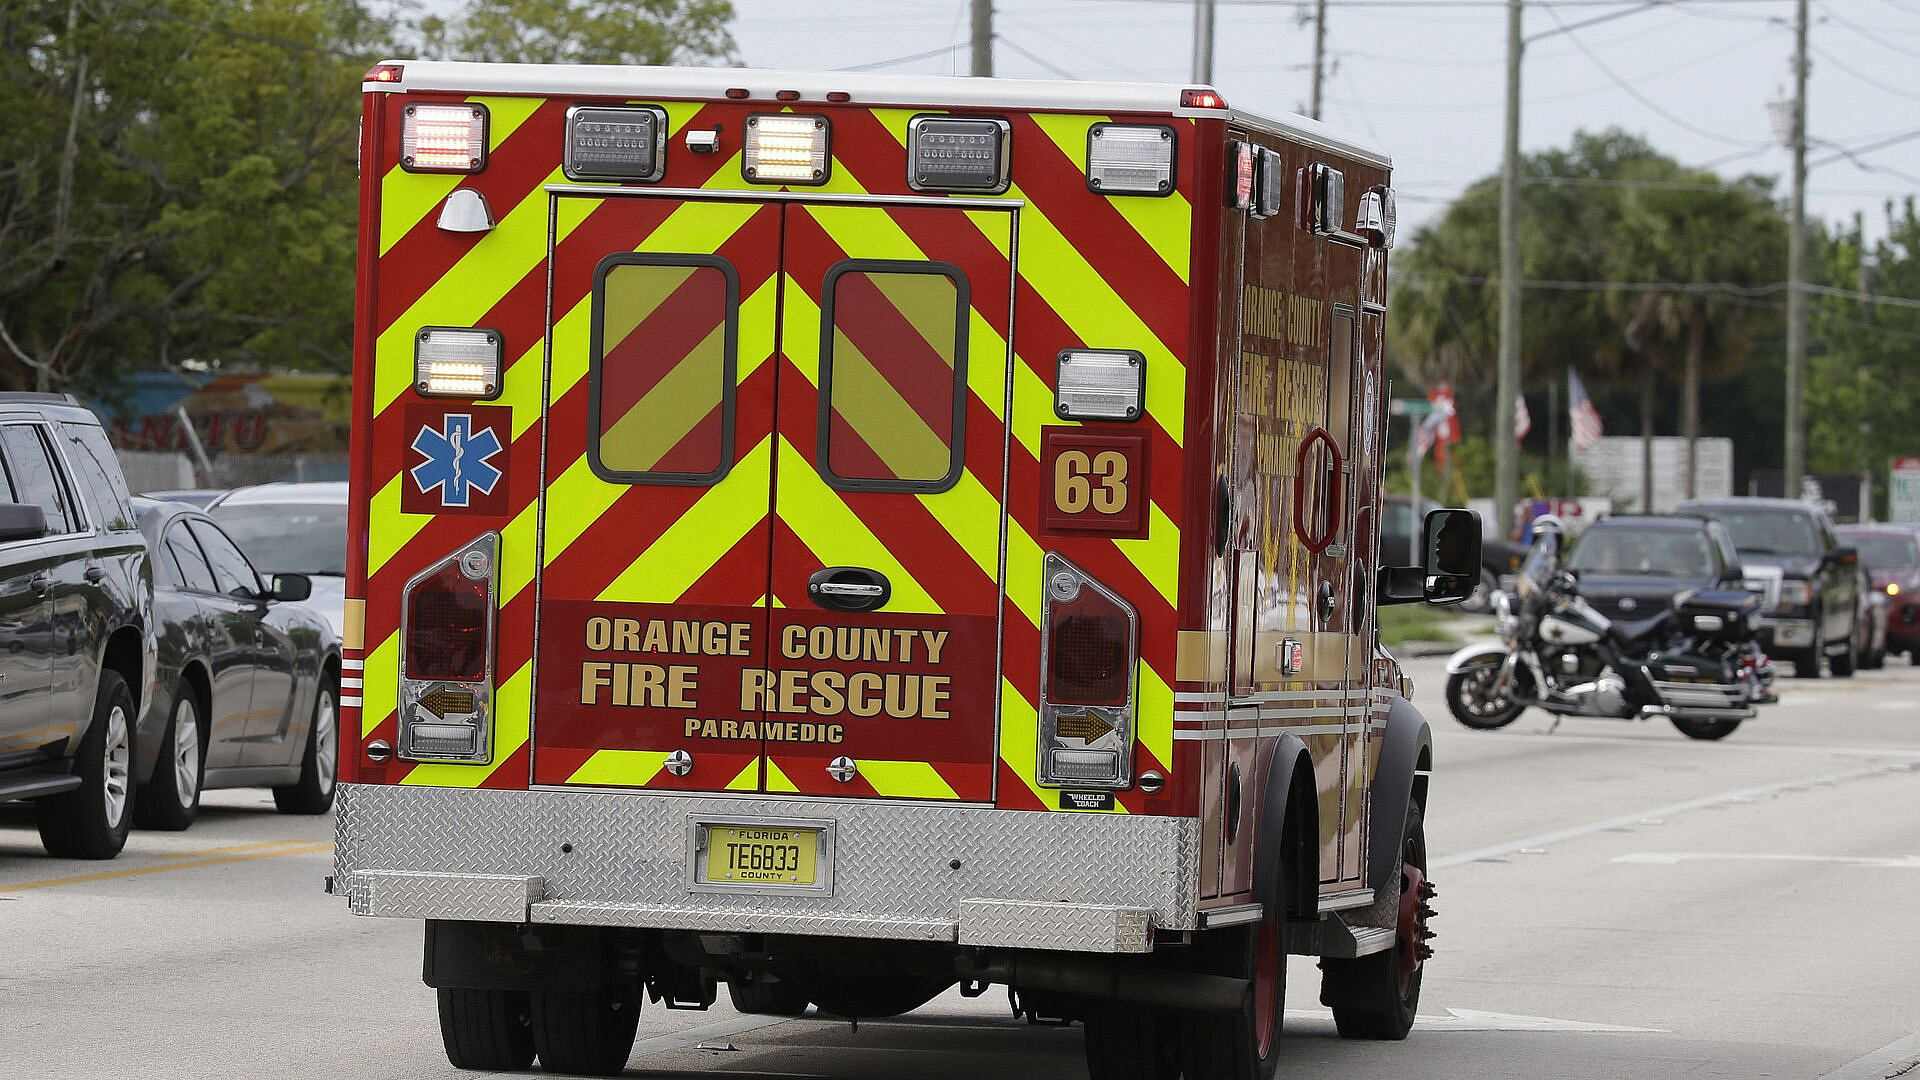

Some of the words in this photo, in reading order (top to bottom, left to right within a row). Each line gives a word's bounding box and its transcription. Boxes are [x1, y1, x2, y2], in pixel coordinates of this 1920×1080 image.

[1243, 283, 1282, 340] ORANGE
[1287, 293, 1324, 348] COUNTY
[1240, 351, 1269, 416] FIRE
[1276, 358, 1322, 425] RESCUE
[1054, 449, 1129, 515] 63
[585, 616, 751, 656] ORANGE
[781, 624, 949, 664] COUNTY
[580, 660, 699, 709] FIRE
[739, 668, 951, 719] RESCUE
[684, 717, 844, 744] PARAMEDIC
[1067, 793, 1106, 801] WHEELED
[1073, 800, 1099, 808] COACH
[739, 831, 789, 841] FLORIDA
[726, 843, 799, 871] TE6833
[740, 871, 783, 880] COUNTY
